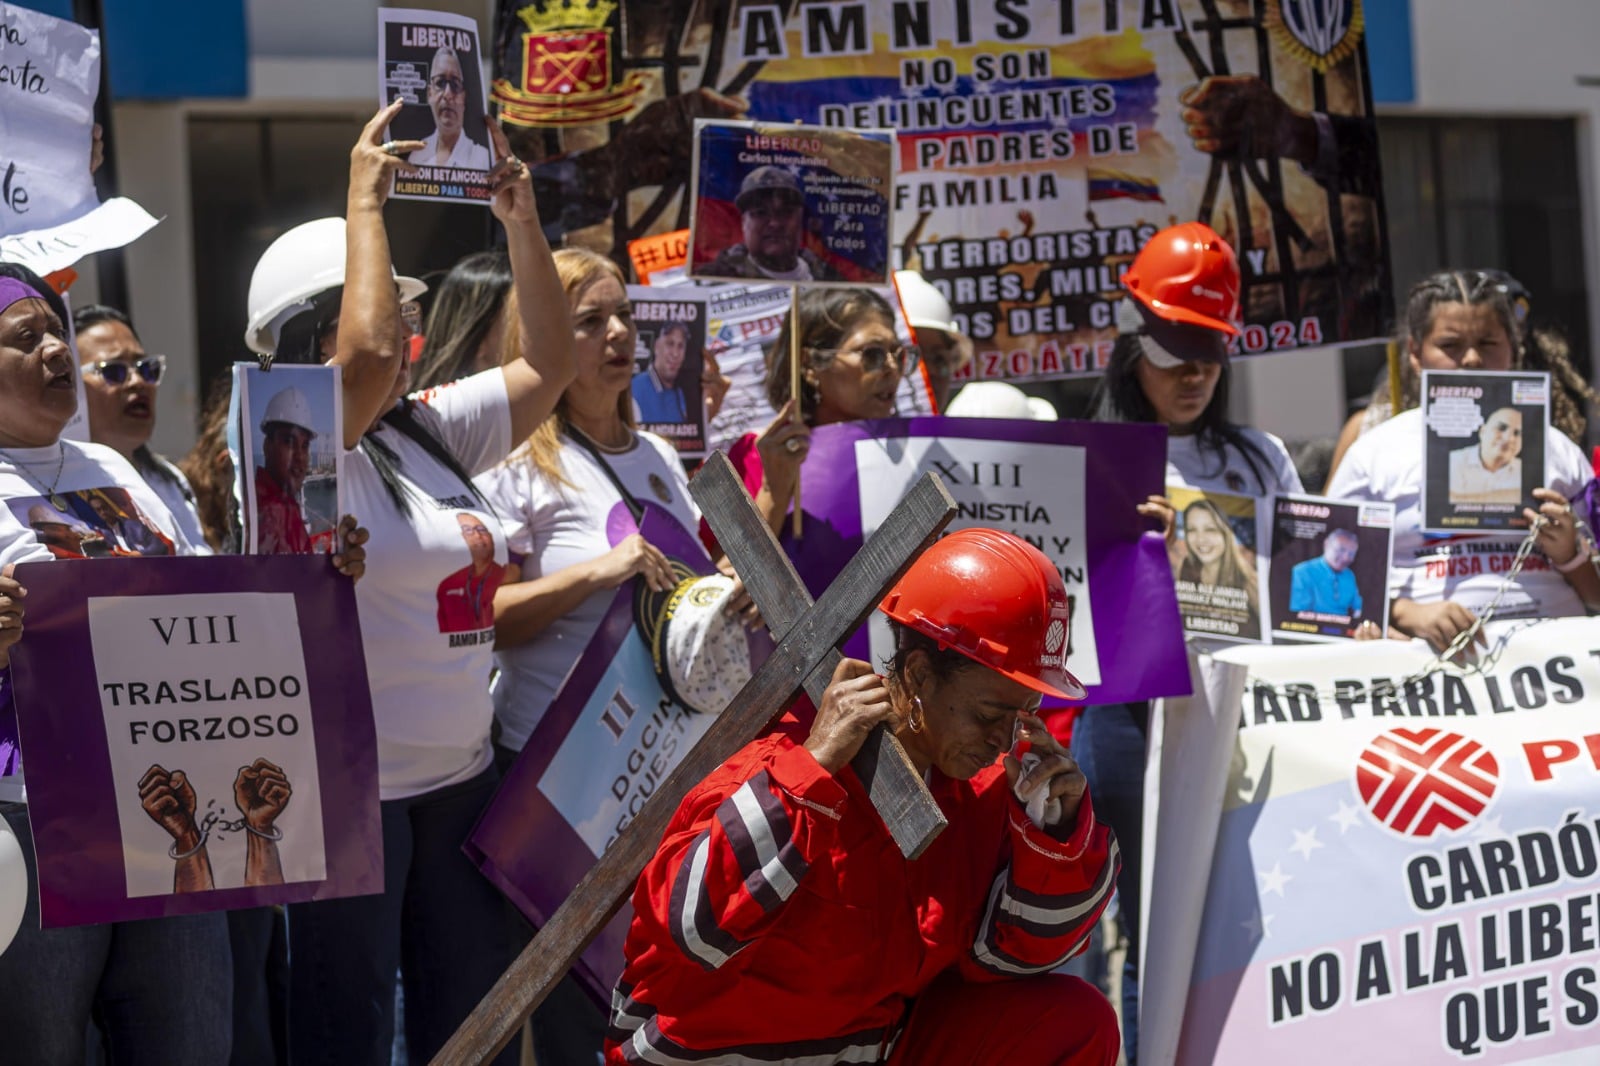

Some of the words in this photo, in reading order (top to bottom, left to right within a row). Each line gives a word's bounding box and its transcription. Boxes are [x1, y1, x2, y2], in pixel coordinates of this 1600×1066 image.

[401, 26, 471, 52] LIBERTAD
[904, 59, 954, 87] NO
[975, 51, 1050, 82] SON
[824, 86, 1113, 128] DELINCUENTES
[738, 153, 773, 164] Carlos
[746, 135, 821, 152] LIBERTAD
[920, 132, 1072, 167] PADRES
[1092, 124, 1137, 153] DE
[396, 182, 440, 195] #LIBERTAD
[441, 184, 465, 197] PARA
[895, 174, 1058, 210] FAMILIA
[818, 202, 880, 216] LIBERTAD
[919, 229, 1156, 271] TERRORISTAS
[1247, 249, 1265, 276] Y
[932, 274, 1036, 304] ORES.
[1010, 304, 1073, 335] DEL
[1430, 385, 1483, 399] LIBERTAD
[933, 459, 1024, 488] XIII
[1278, 502, 1331, 519] LIBERTAD
[1053, 537, 1071, 555] Y
[1425, 555, 1483, 578] PDVSA
[150, 614, 240, 646] VIII
[1186, 616, 1240, 635] LIBERTAD
[103, 675, 301, 706] TRASLADO
[1335, 670, 1478, 721] PARA
[1485, 655, 1584, 714] LOS
[129, 713, 299, 744] FORZOSO
[600, 687, 637, 743] II
[1407, 812, 1600, 911] CARDÓ
[1271, 952, 1341, 1024] NO
[1356, 940, 1392, 1002] A
[1404, 922, 1468, 990] LA
[1481, 893, 1600, 972] LIBE
[1446, 975, 1551, 1056] QUE
